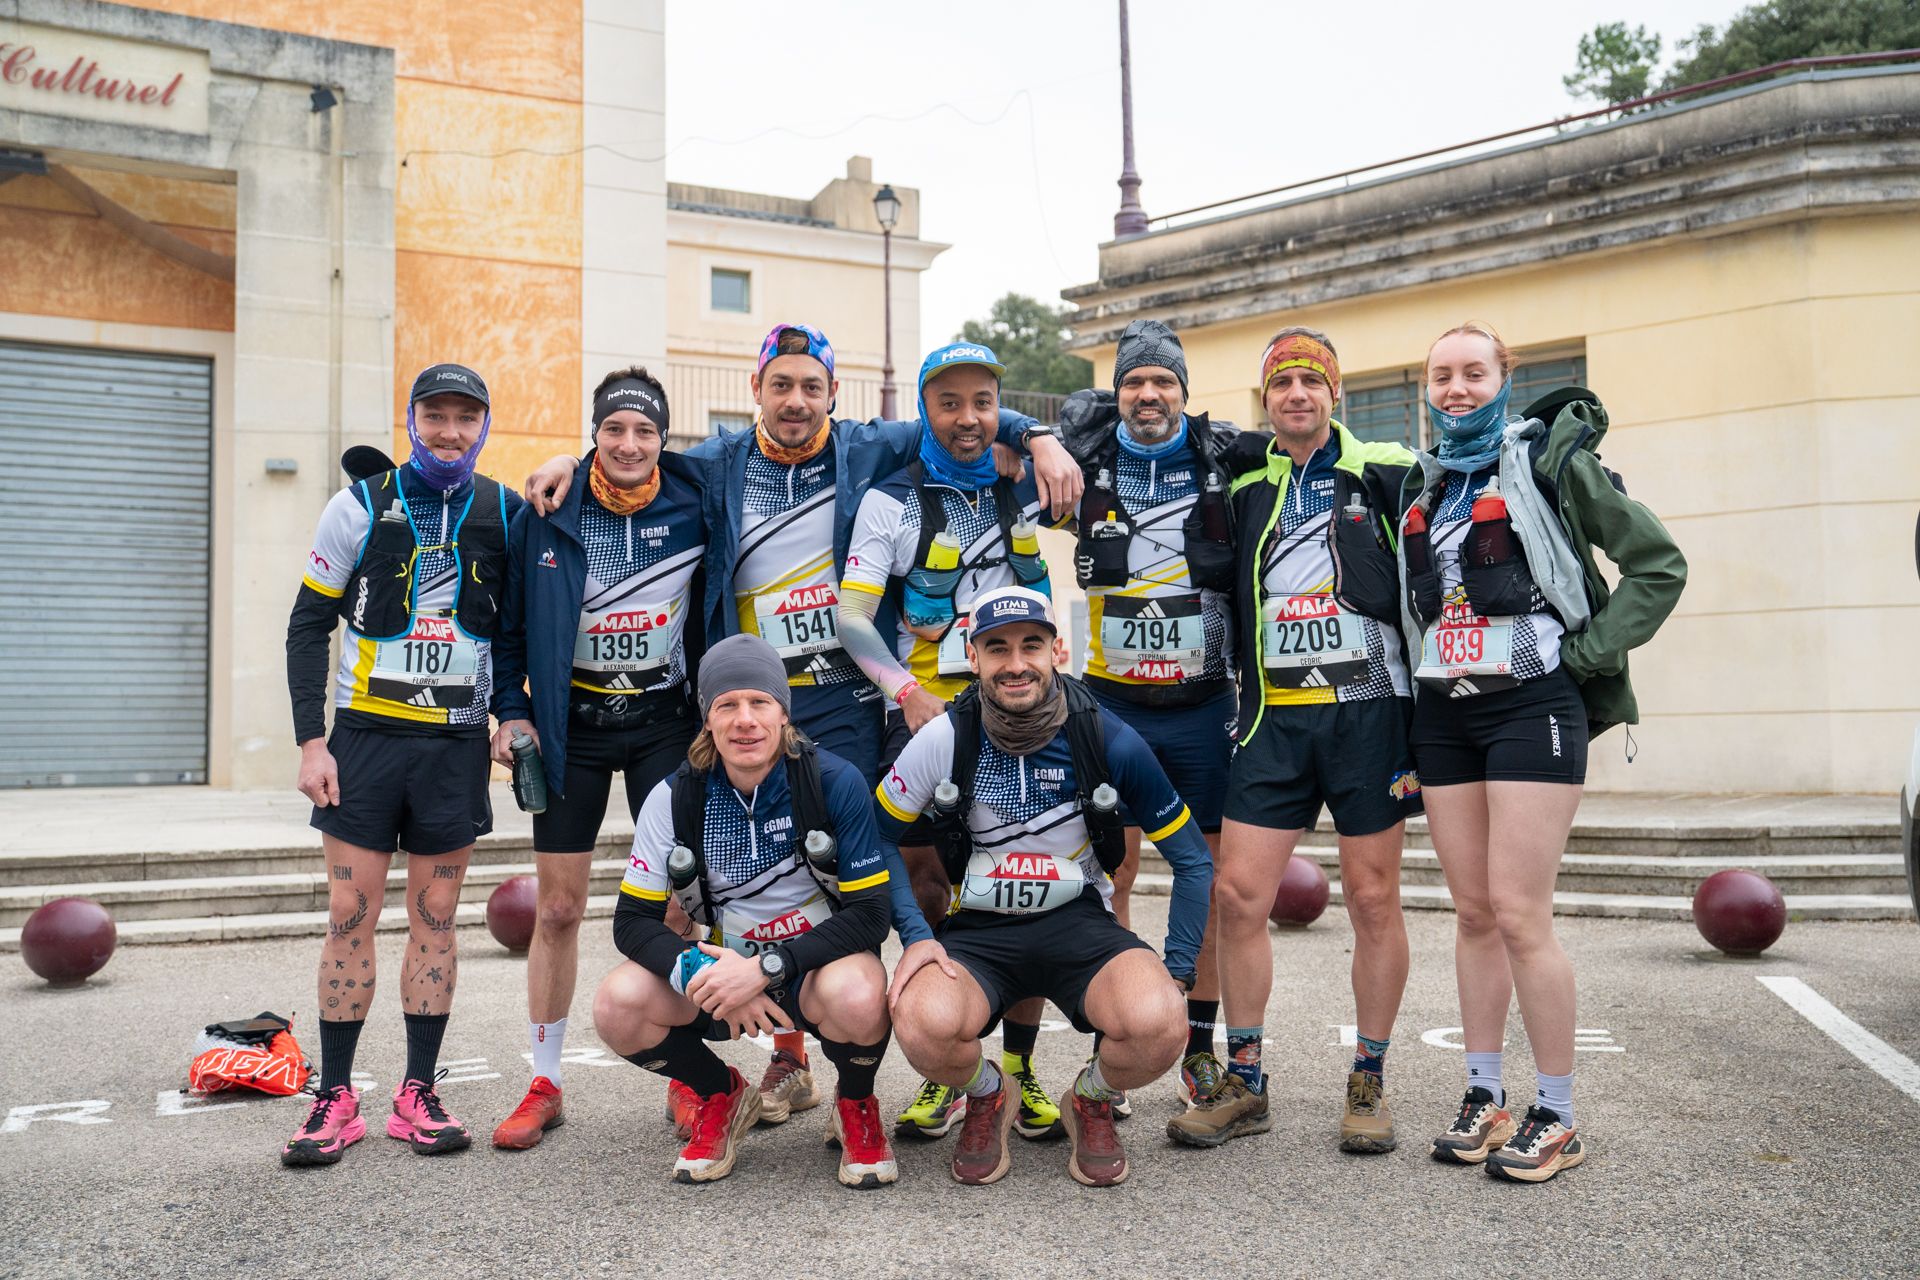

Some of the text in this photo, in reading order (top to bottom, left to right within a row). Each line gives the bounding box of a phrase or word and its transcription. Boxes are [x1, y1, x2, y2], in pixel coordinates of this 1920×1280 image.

[0, 43, 183, 106] Culturel
[942, 348, 987, 362] HOKA
[437, 372, 468, 383] HOKA
[607, 388, 652, 401] helvetia
[800, 464, 826, 479] EGMA
[1163, 470, 1192, 483] EGMA
[1311, 479, 1335, 490] EGM
[640, 525, 670, 539] EGMA
[649, 538, 663, 548] MIA
[353, 576, 369, 632] HOKA
[784, 588, 832, 610] MAIF
[993, 600, 1029, 610] UTMB
[1283, 598, 1334, 618] MAIF
[409, 621, 453, 638] MAIF
[600, 613, 650, 631] MAIF
[781, 607, 837, 645] 1541
[1123, 619, 1182, 650] 2194
[1277, 616, 1343, 655] 2209
[589, 632, 649, 661] 1395
[801, 644, 827, 654] MICHAEL
[1190, 649, 1201, 658] M3
[1351, 649, 1363, 659] M3
[1435, 629, 1484, 664] 1839
[403, 641, 453, 674] 1187
[658, 655, 667, 664] SE
[1137, 653, 1168, 662] STEPHANE
[1300, 656, 1323, 666] CEDRIC
[1133, 662, 1181, 679] MAIF
[1496, 663, 1507, 673] SE
[412, 677, 440, 686] FLORENT
[463, 676, 473, 685] SE
[1551, 724, 1562, 757] TERREX
[1034, 768, 1066, 780] EGMA
[764, 815, 793, 834] EGMA
[773, 832, 787, 842] MIA
[851, 854, 881, 870] Mulhouse
[999, 857, 1054, 876] MAIF
[333, 865, 352, 880] RUN
[433, 864, 461, 879] FAST
[993, 880, 1051, 908] 1157
[754, 912, 806, 939] MAIF
